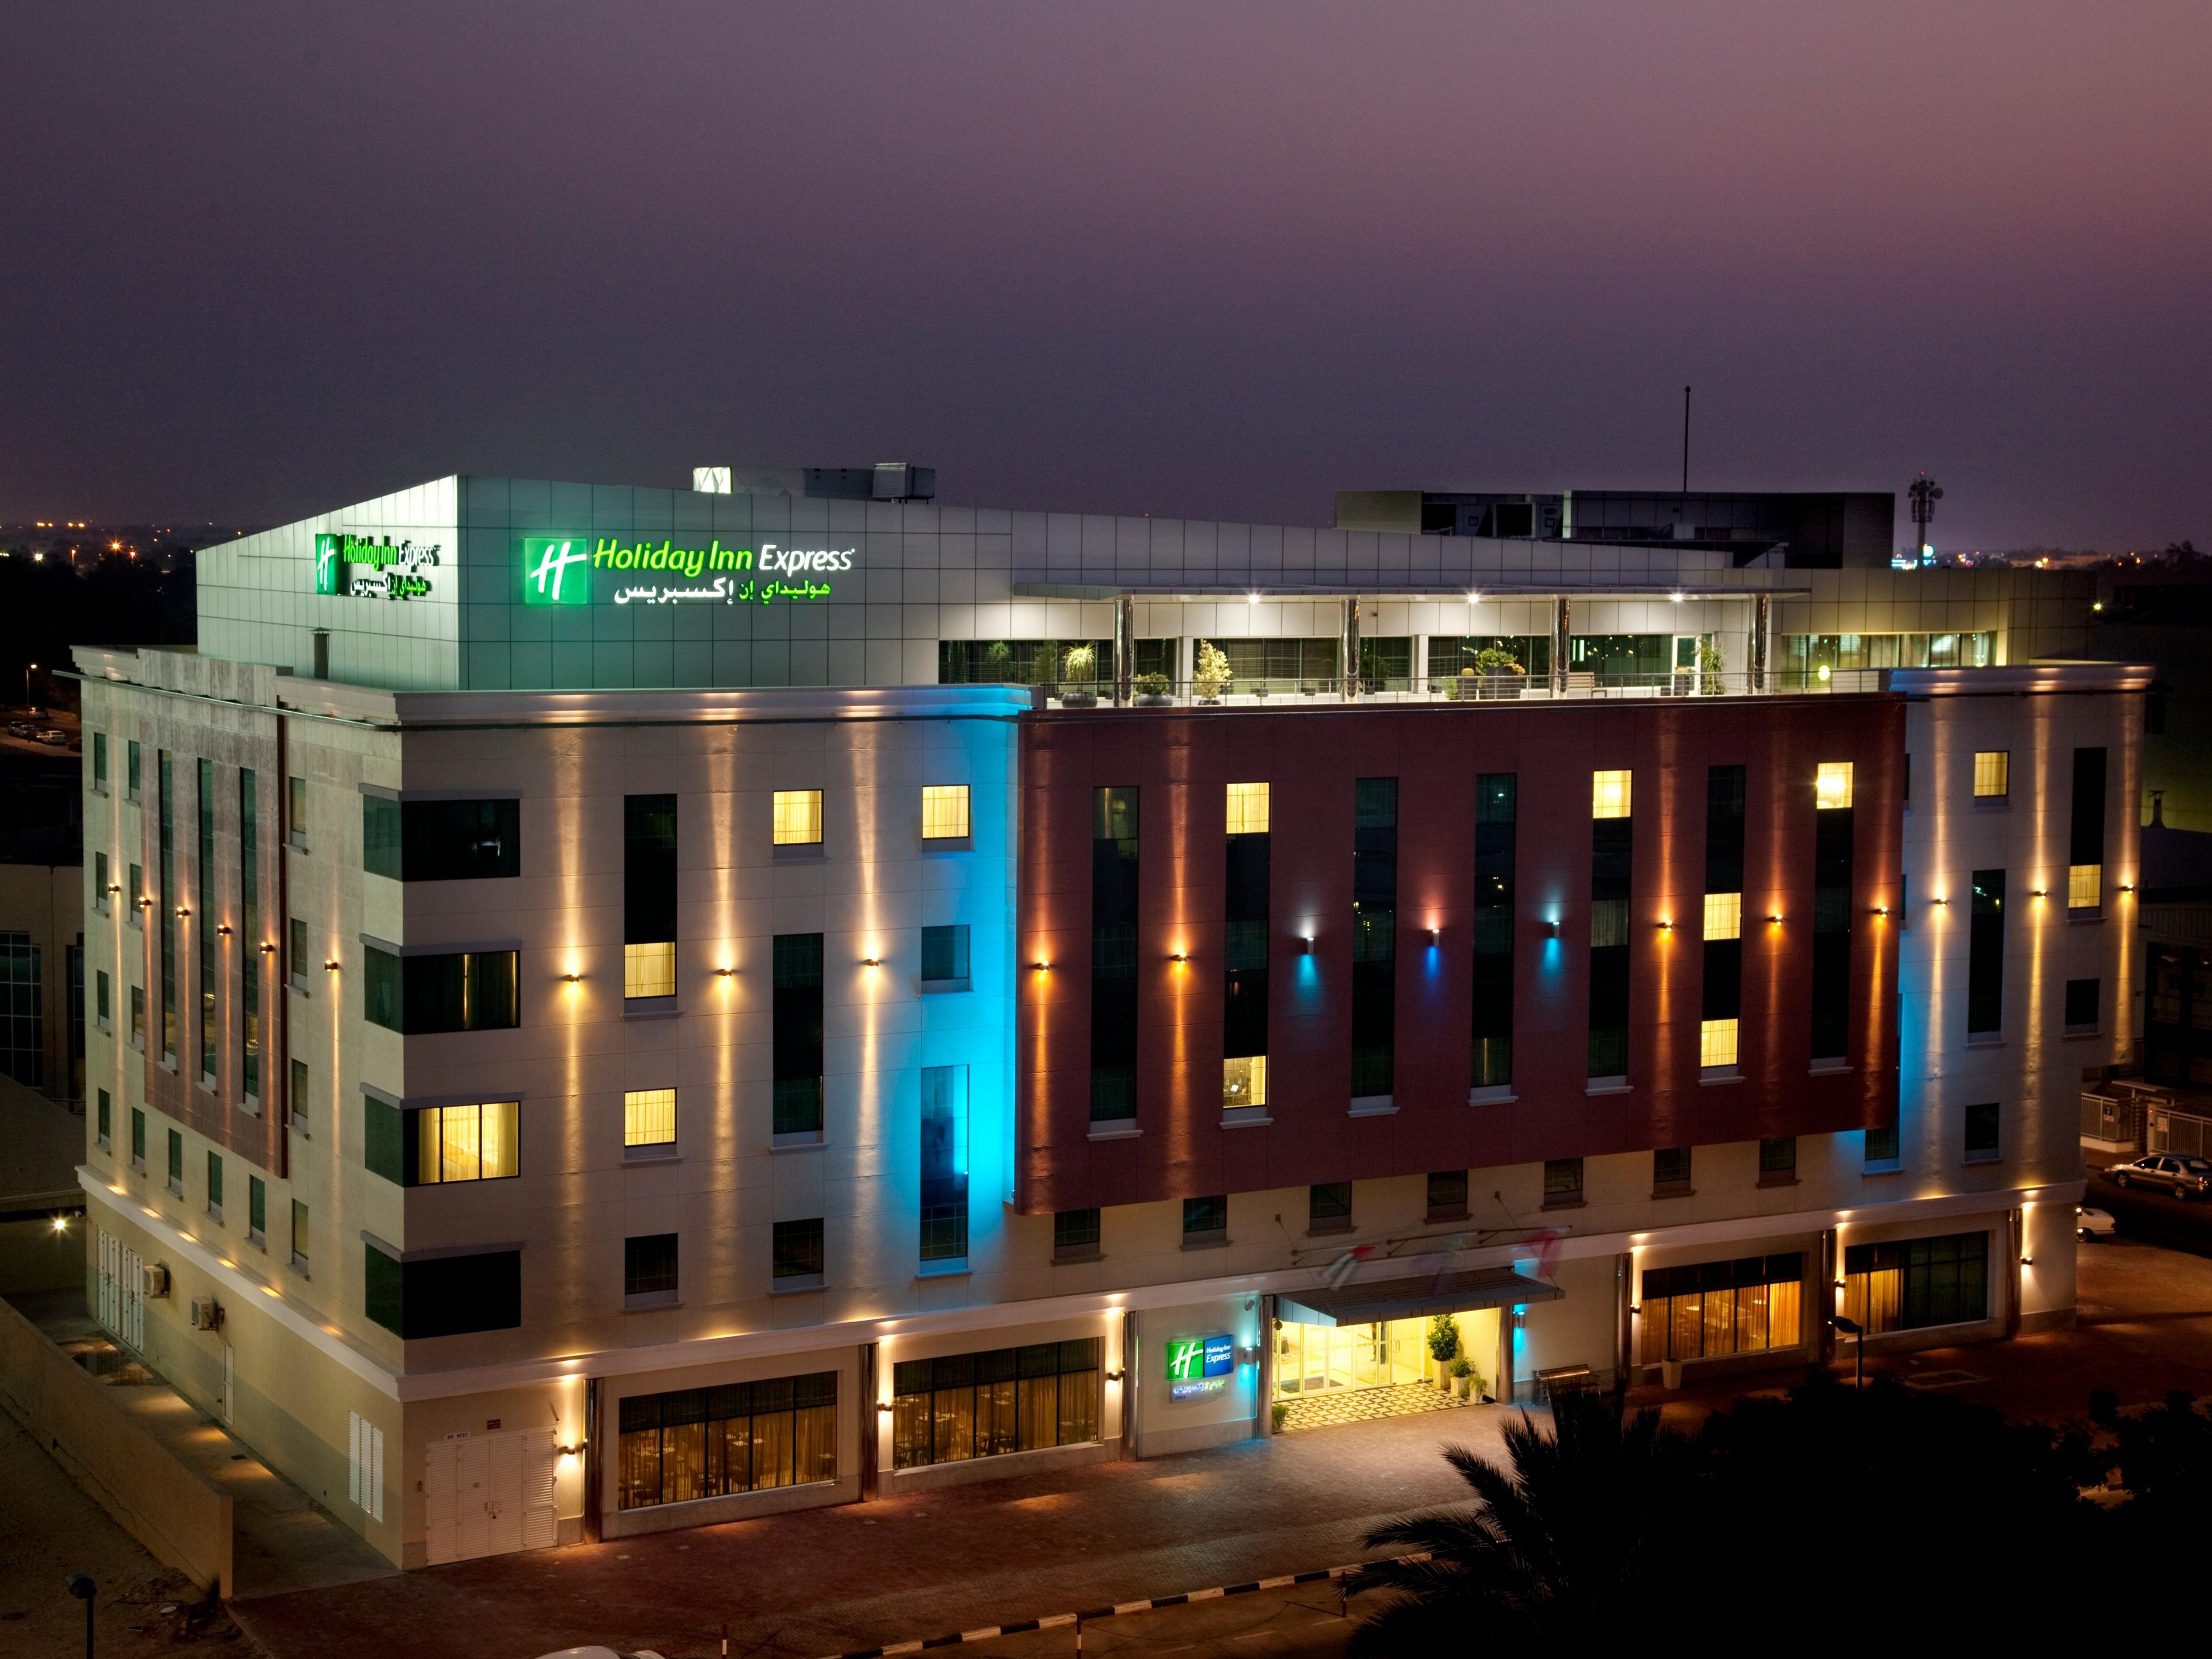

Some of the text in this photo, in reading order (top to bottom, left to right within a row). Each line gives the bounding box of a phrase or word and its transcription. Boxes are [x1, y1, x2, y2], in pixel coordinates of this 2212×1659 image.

[343, 534, 434, 572] Holiday Inn Express
[592, 538, 853, 578] Holiday Inn Express
[614, 577, 831, 604] هوليداي إن إكسبريس
[1206, 1353, 1231, 1364] Express
